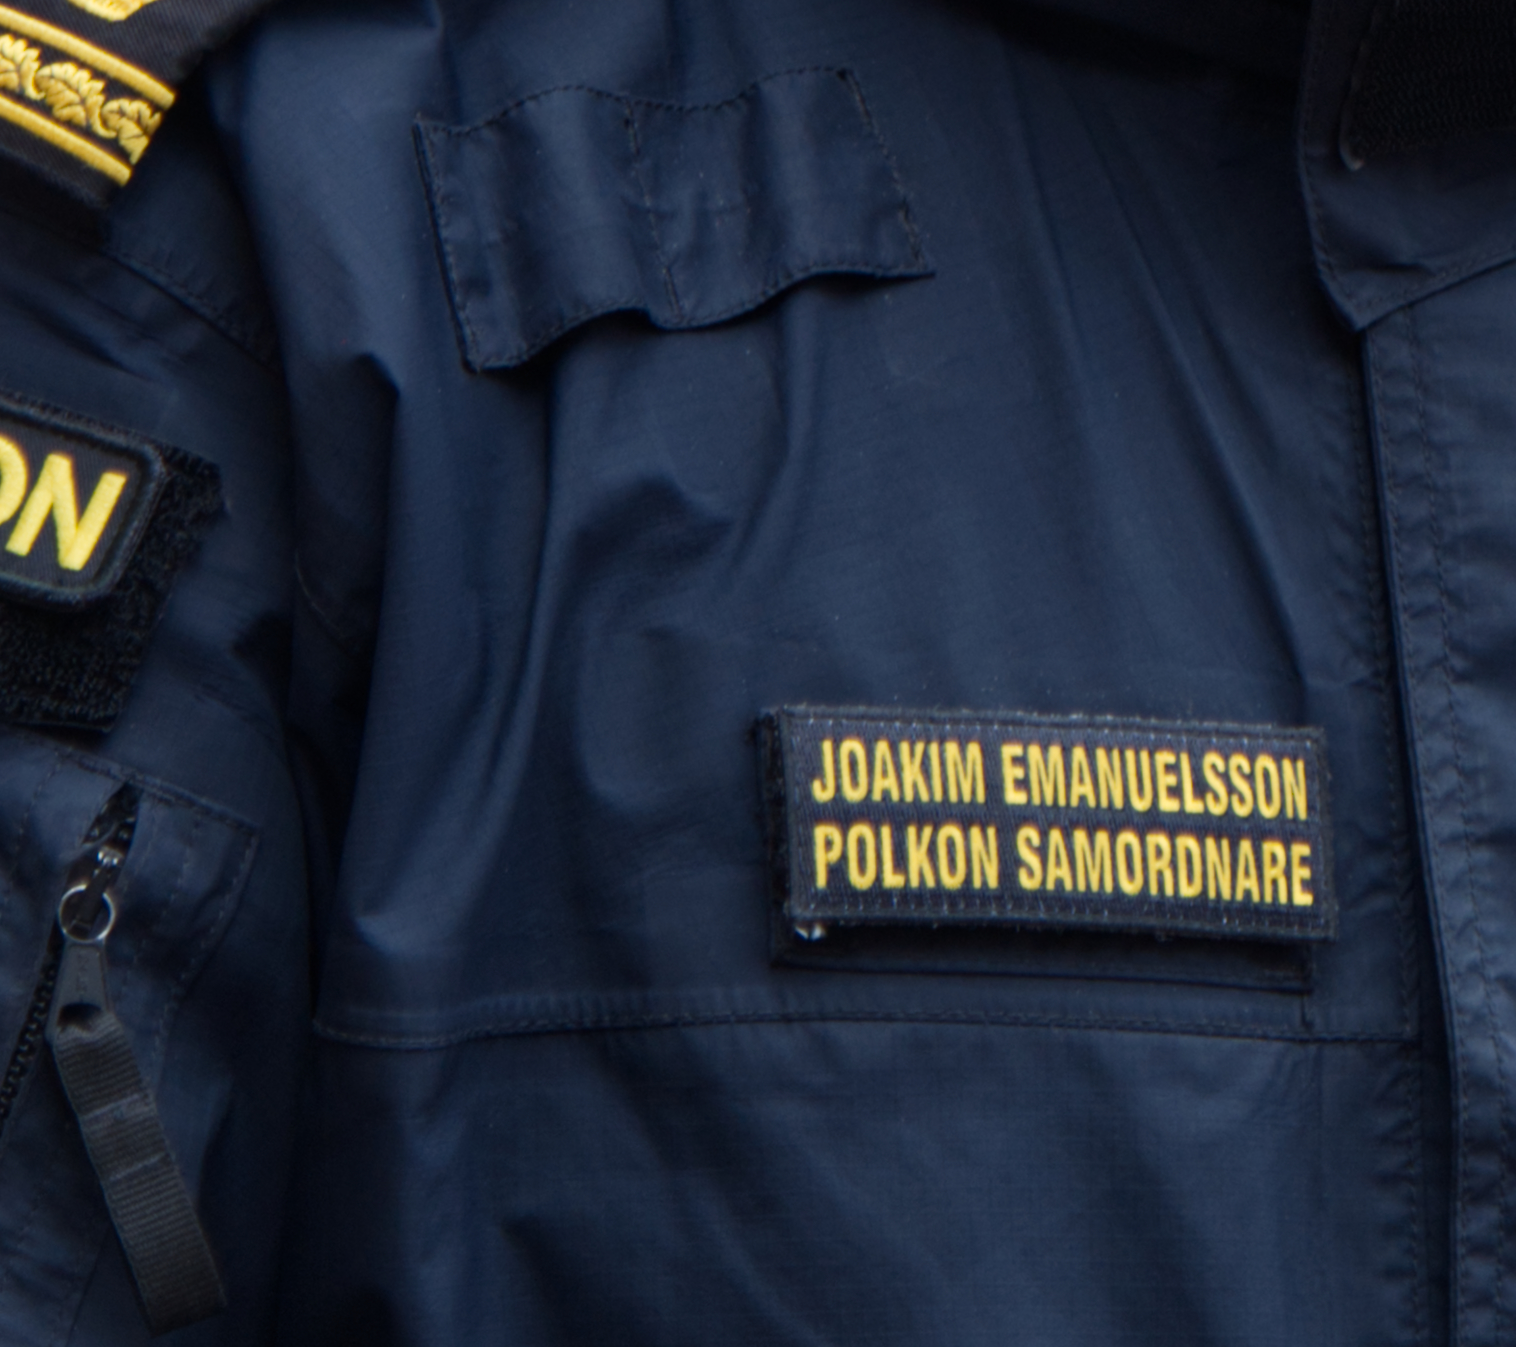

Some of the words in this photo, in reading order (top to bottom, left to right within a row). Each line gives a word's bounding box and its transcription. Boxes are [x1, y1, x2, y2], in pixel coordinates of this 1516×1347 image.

[812, 738, 986, 804] JOAKIM
[1000, 742, 1308, 821] EMANUELSSON
[814, 821, 999, 890] POLKON
[1016, 824, 1314, 906] SAMORDNARE
